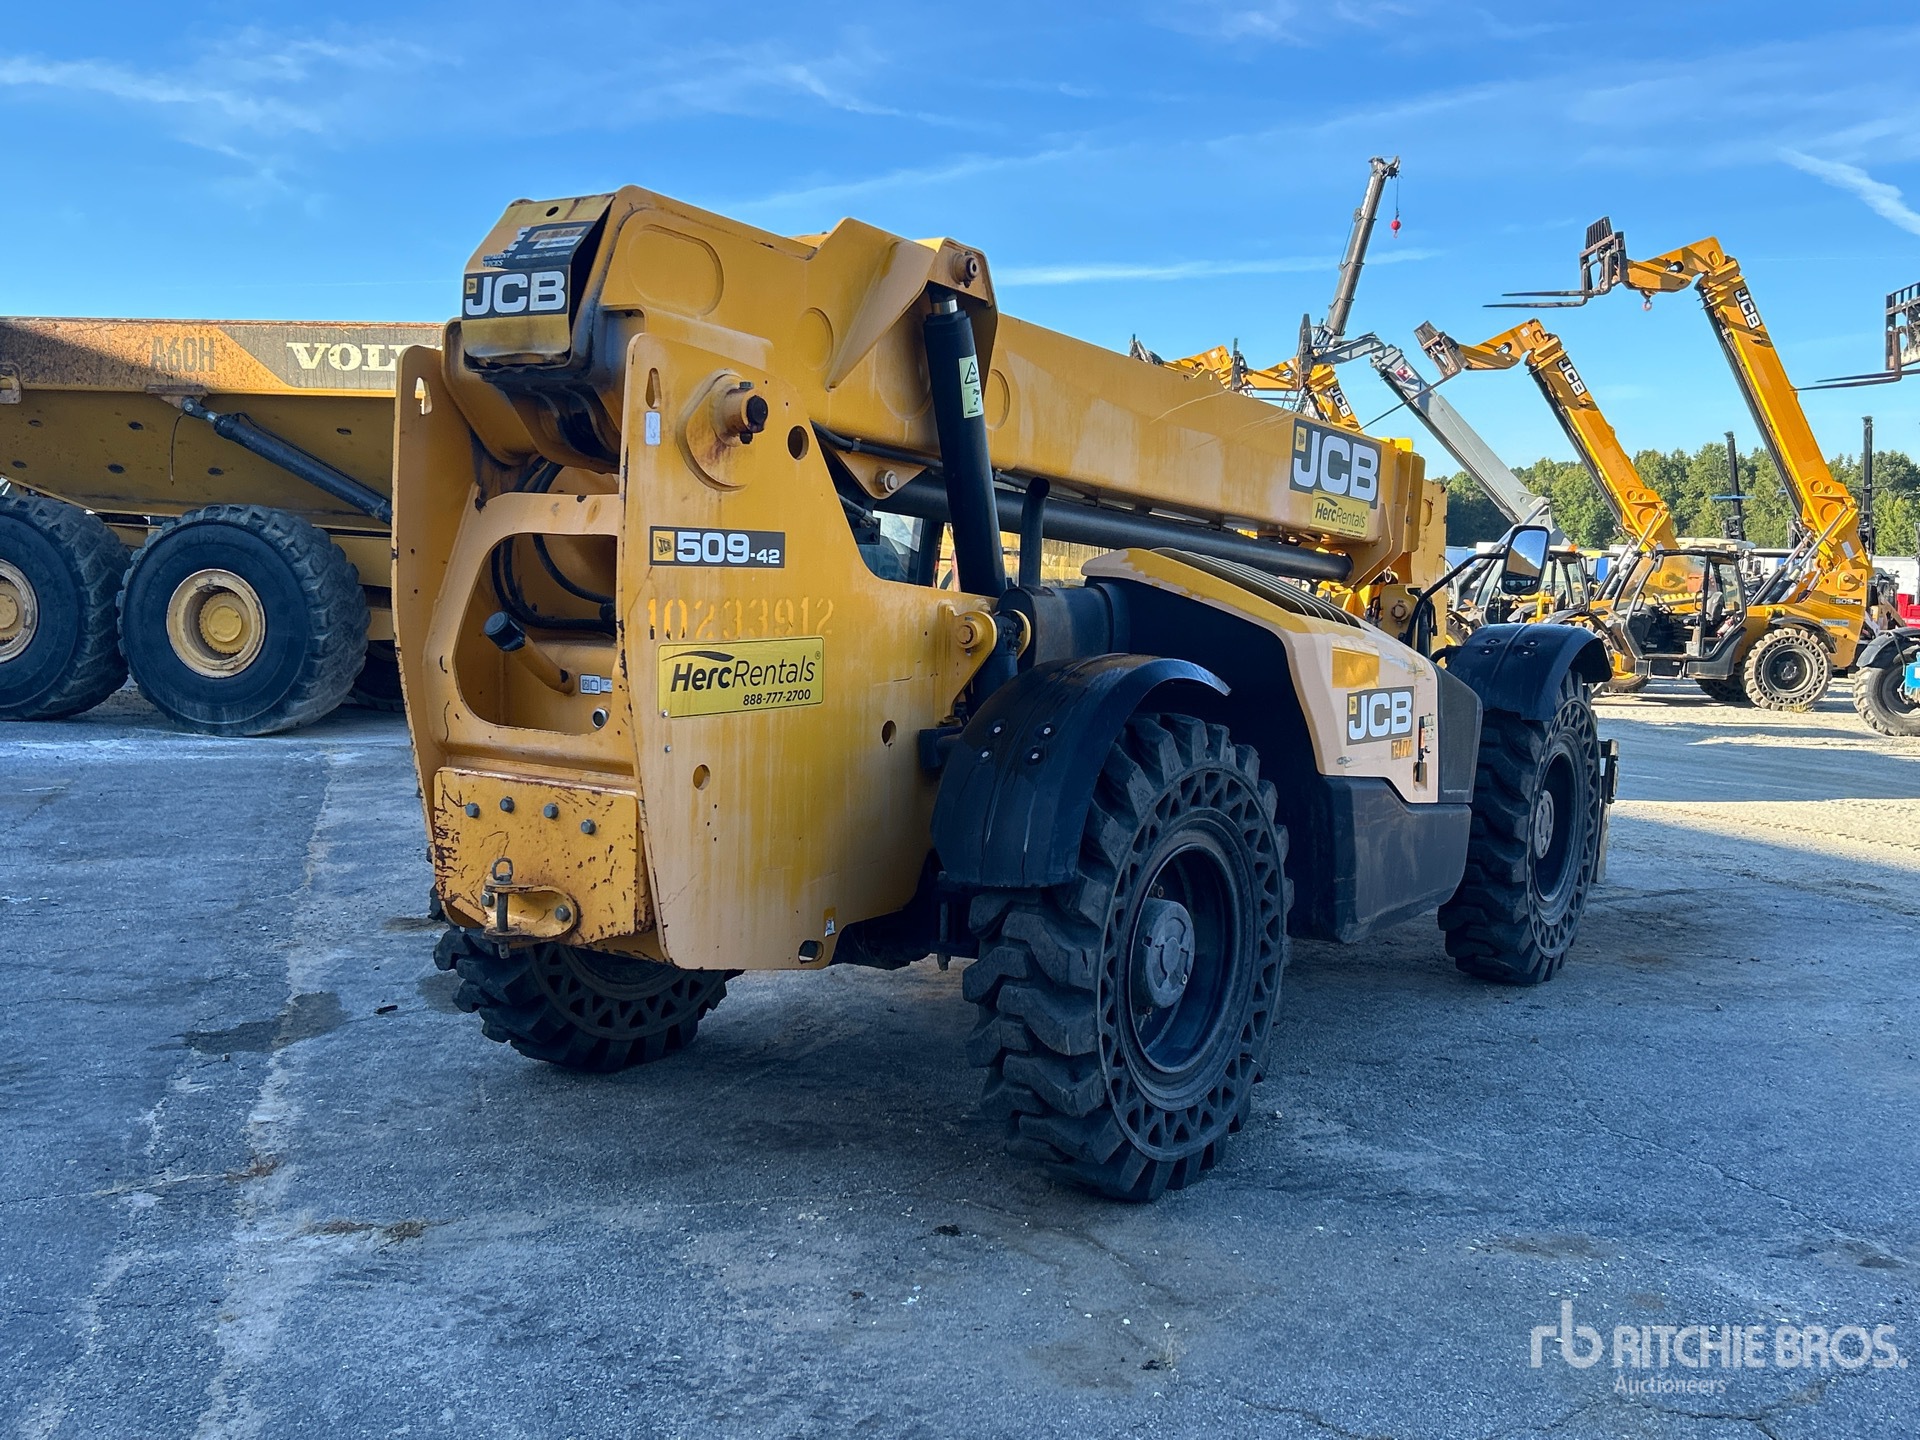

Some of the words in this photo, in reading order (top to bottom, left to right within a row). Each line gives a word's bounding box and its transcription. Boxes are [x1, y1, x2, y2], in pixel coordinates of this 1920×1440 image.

[465, 271, 566, 316] JCB
[1735, 290, 1761, 328] JCB
[151, 337, 215, 372] A60H
[286, 342, 437, 372] VOL
[1558, 360, 1586, 396] JCB
[1329, 387, 1352, 418] JCB
[1293, 431, 1379, 501] JCB
[676, 531, 780, 564] 509-42
[742, 690, 811, 706] 888-777-2700
[1348, 691, 1412, 740] JCB
